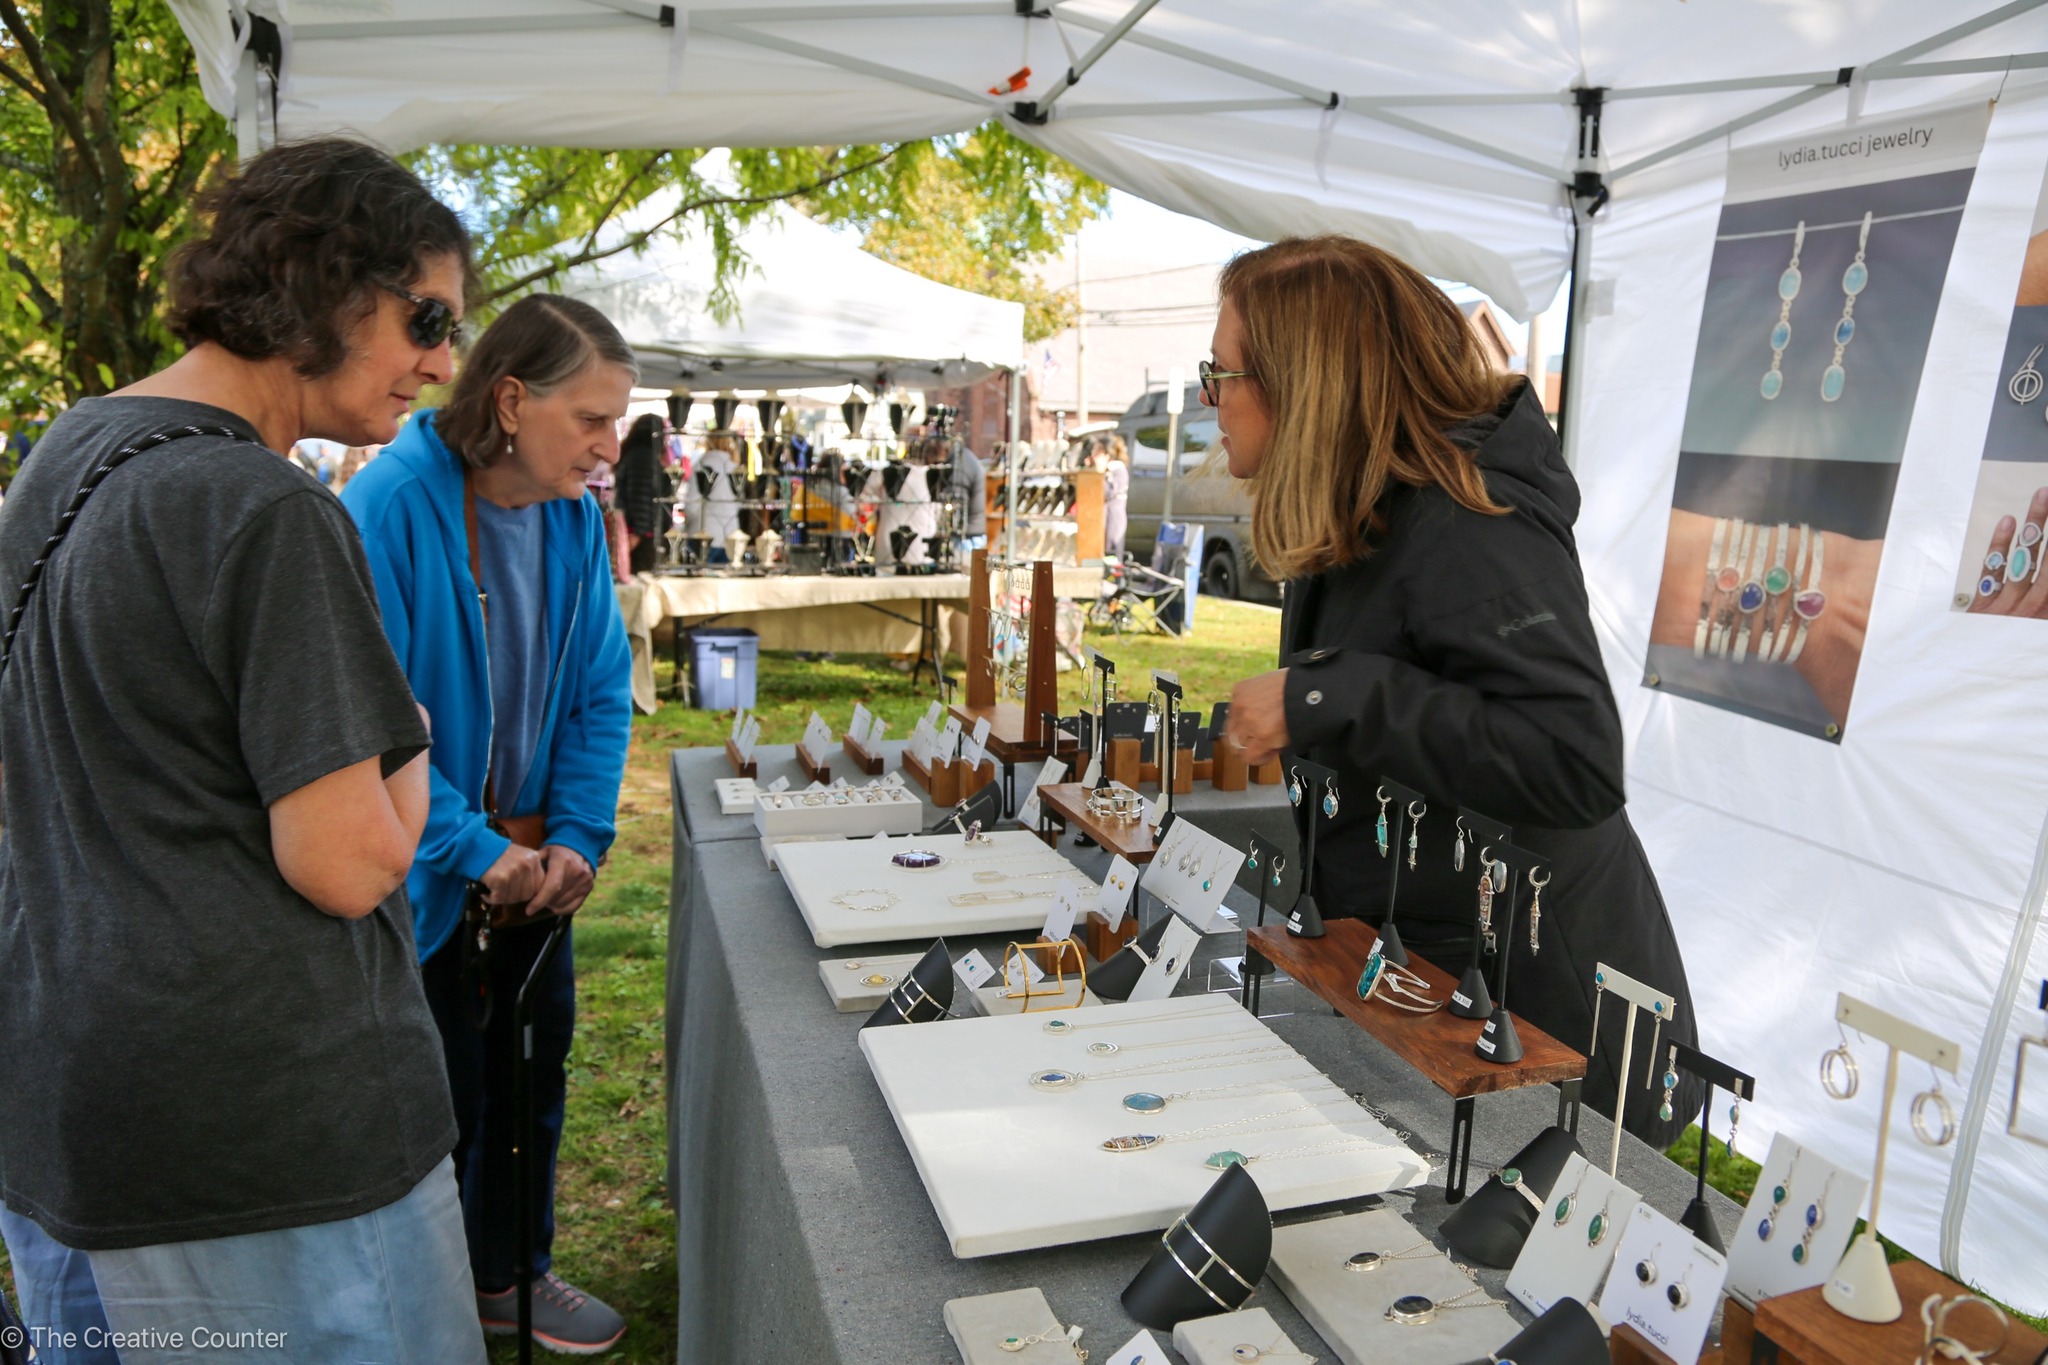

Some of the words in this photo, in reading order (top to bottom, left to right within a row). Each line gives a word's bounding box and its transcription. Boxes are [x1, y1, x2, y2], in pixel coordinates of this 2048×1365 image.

[1778, 136, 1863, 171] lydia.tucci
[1865, 127, 1934, 157] jewelry
[1626, 1306, 1669, 1346] lydia.tucci
